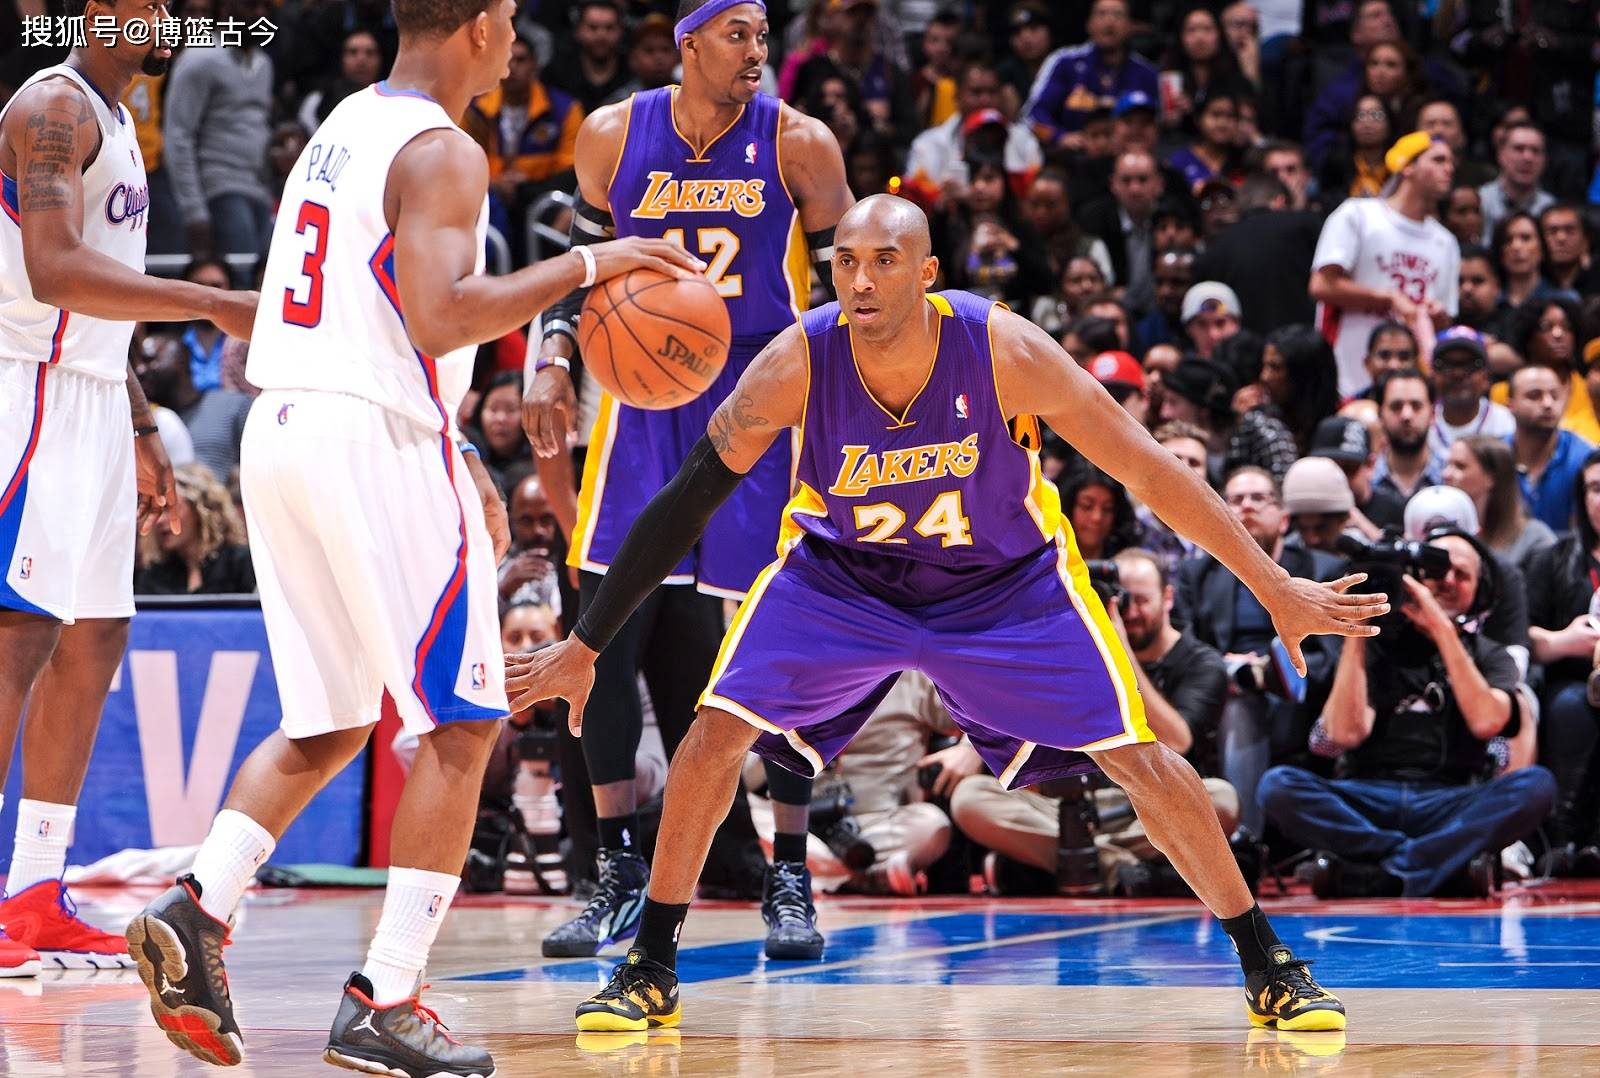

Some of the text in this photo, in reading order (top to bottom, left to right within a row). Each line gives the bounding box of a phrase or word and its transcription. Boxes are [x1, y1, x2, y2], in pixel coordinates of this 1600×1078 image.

[630, 171, 766, 219] LAKERS
[283, 199, 330, 329] 3
[828, 432, 980, 497] LAKERS
[852, 490, 974, 549] 24
